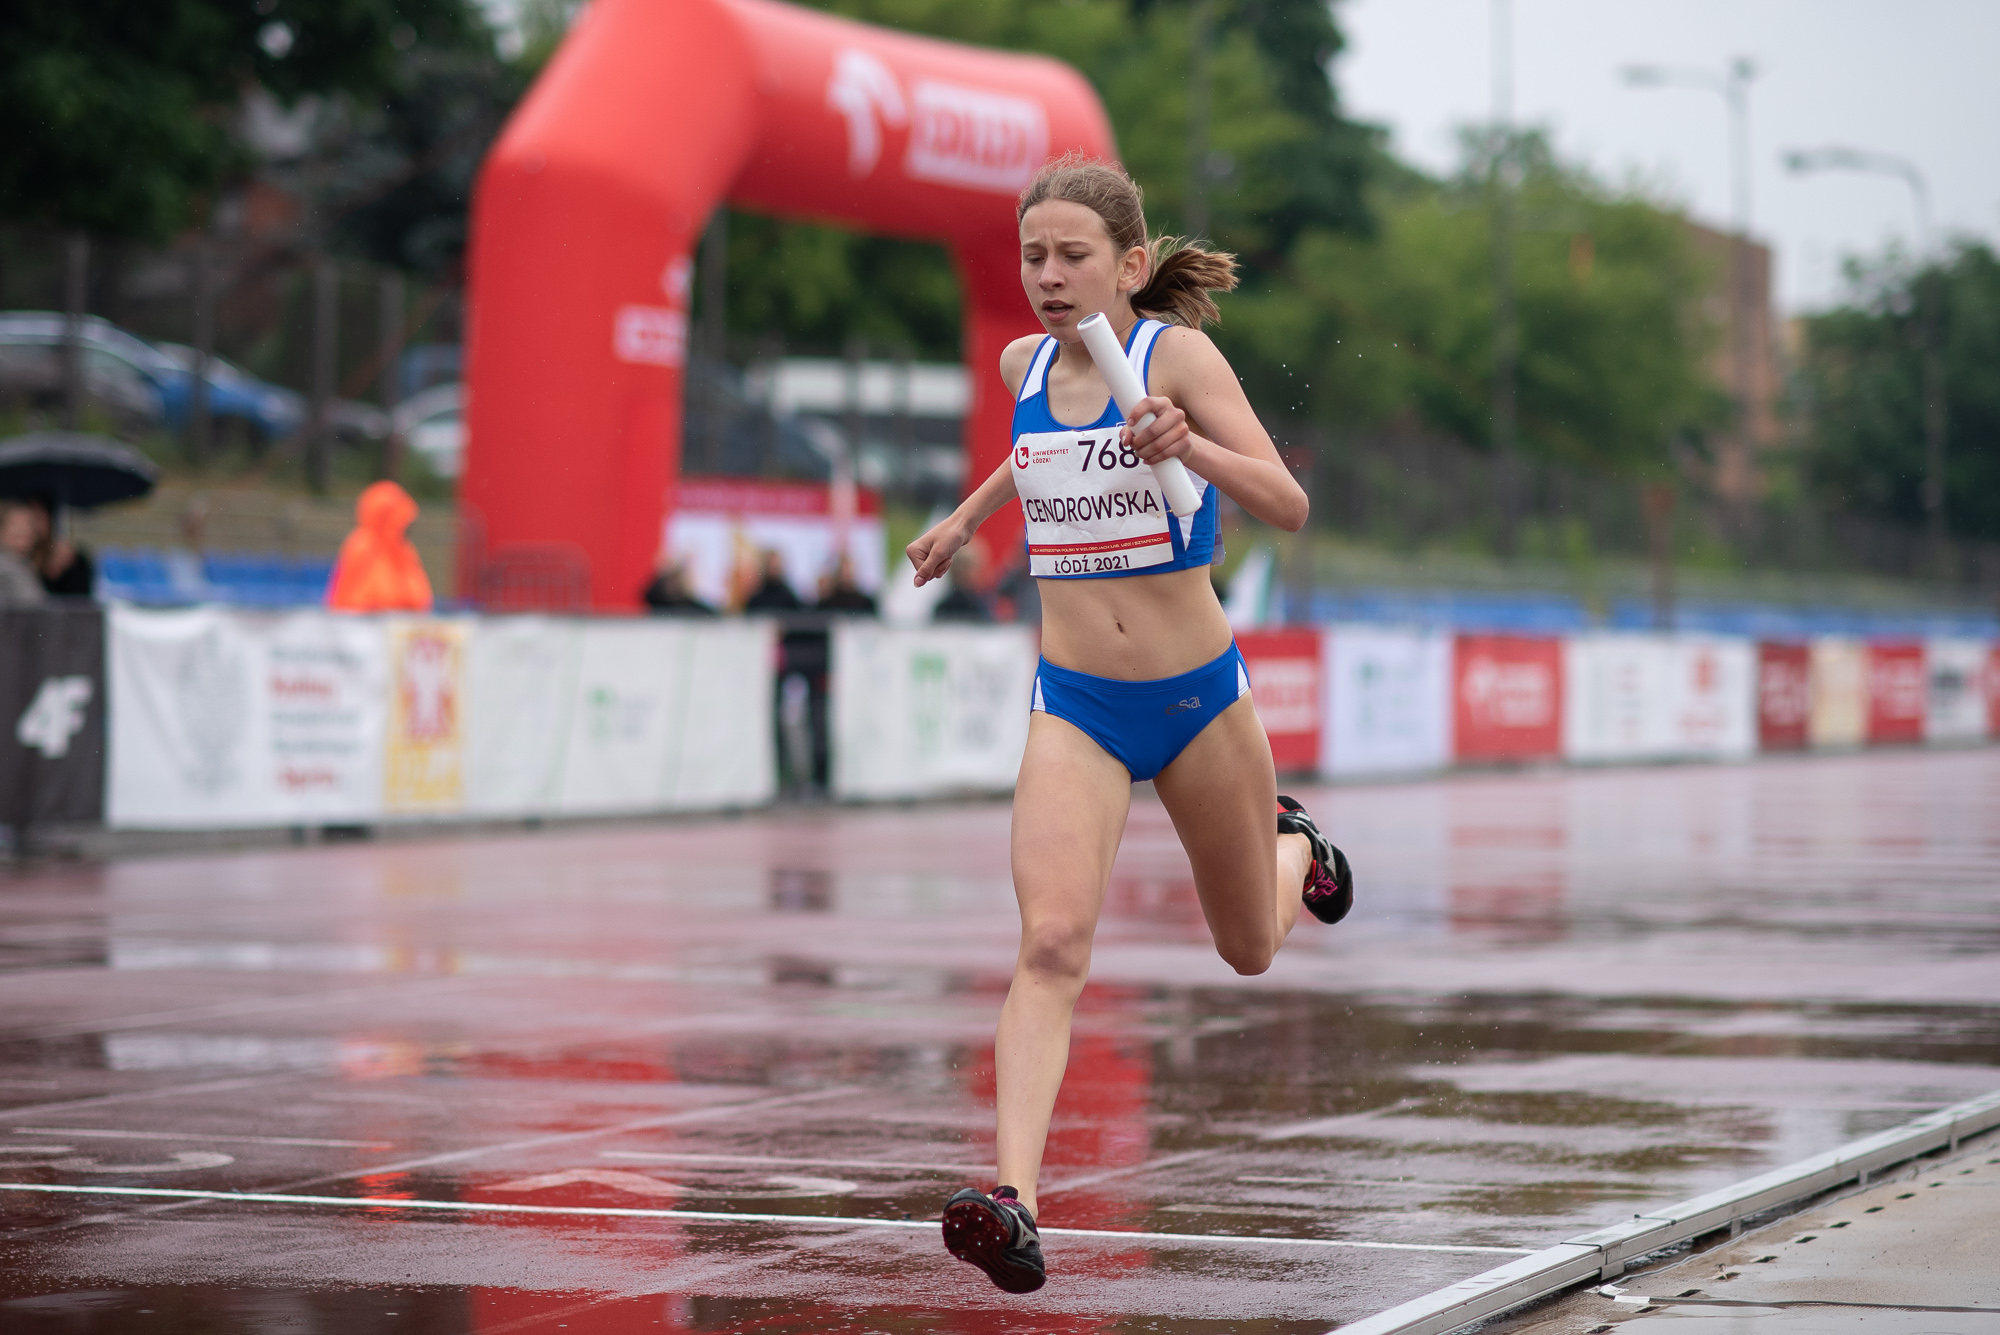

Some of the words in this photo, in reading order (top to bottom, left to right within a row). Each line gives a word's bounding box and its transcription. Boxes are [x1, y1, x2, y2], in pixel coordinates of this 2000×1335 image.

[1032, 448, 1069, 457] UNIWERSYTET
[1077, 438, 1140, 472] 768
[1026, 489, 1160, 523] CENDROWSKA
[1054, 554, 1091, 574] ŁÓDŹ
[1093, 554, 1130, 572] 2021
[15, 673, 94, 760] 4F
